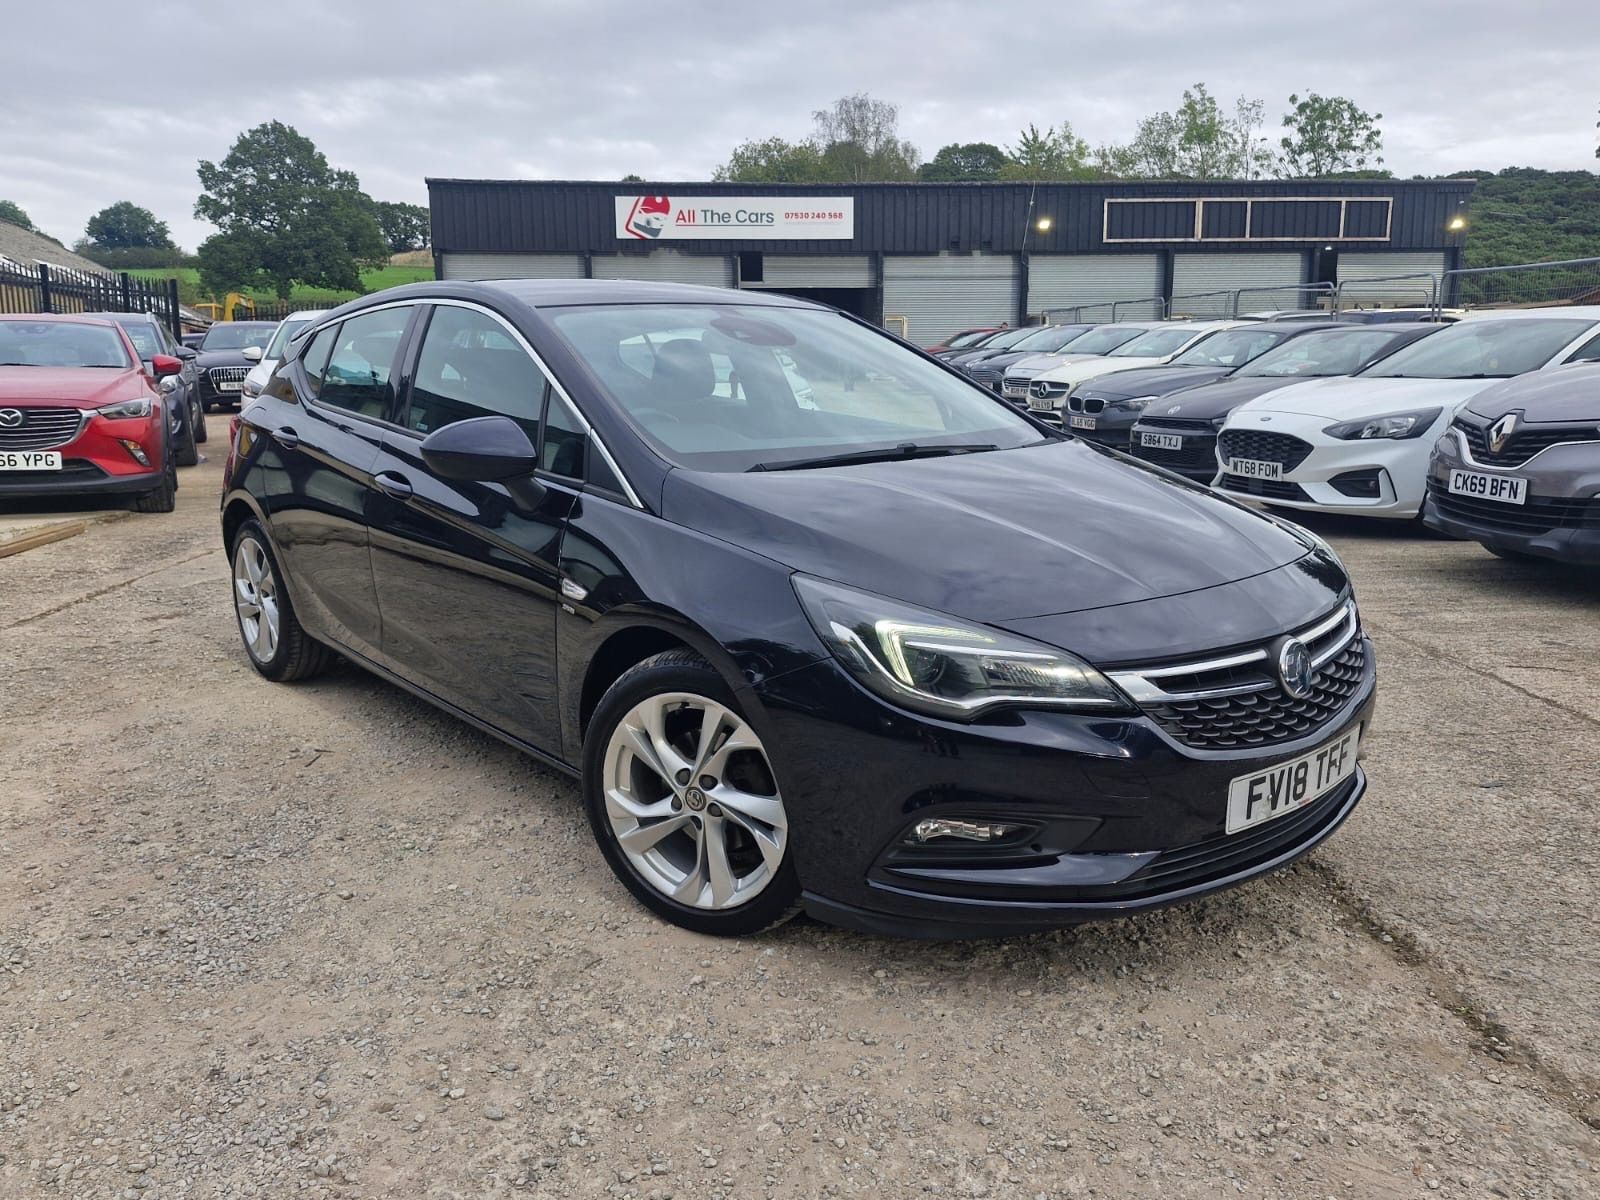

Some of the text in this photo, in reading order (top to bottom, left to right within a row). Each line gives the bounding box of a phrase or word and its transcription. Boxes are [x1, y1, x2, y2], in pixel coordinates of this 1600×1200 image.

[675, 209, 775, 223] All The Cars
[1143, 433, 1179, 448] SB64 TXJ
[22, 454, 55, 466] YPG
[1233, 459, 1278, 478] WT68 FOM
[1454, 473, 1519, 499] CK69 BFN
[1246, 735, 1351, 820] FV18 TFF
